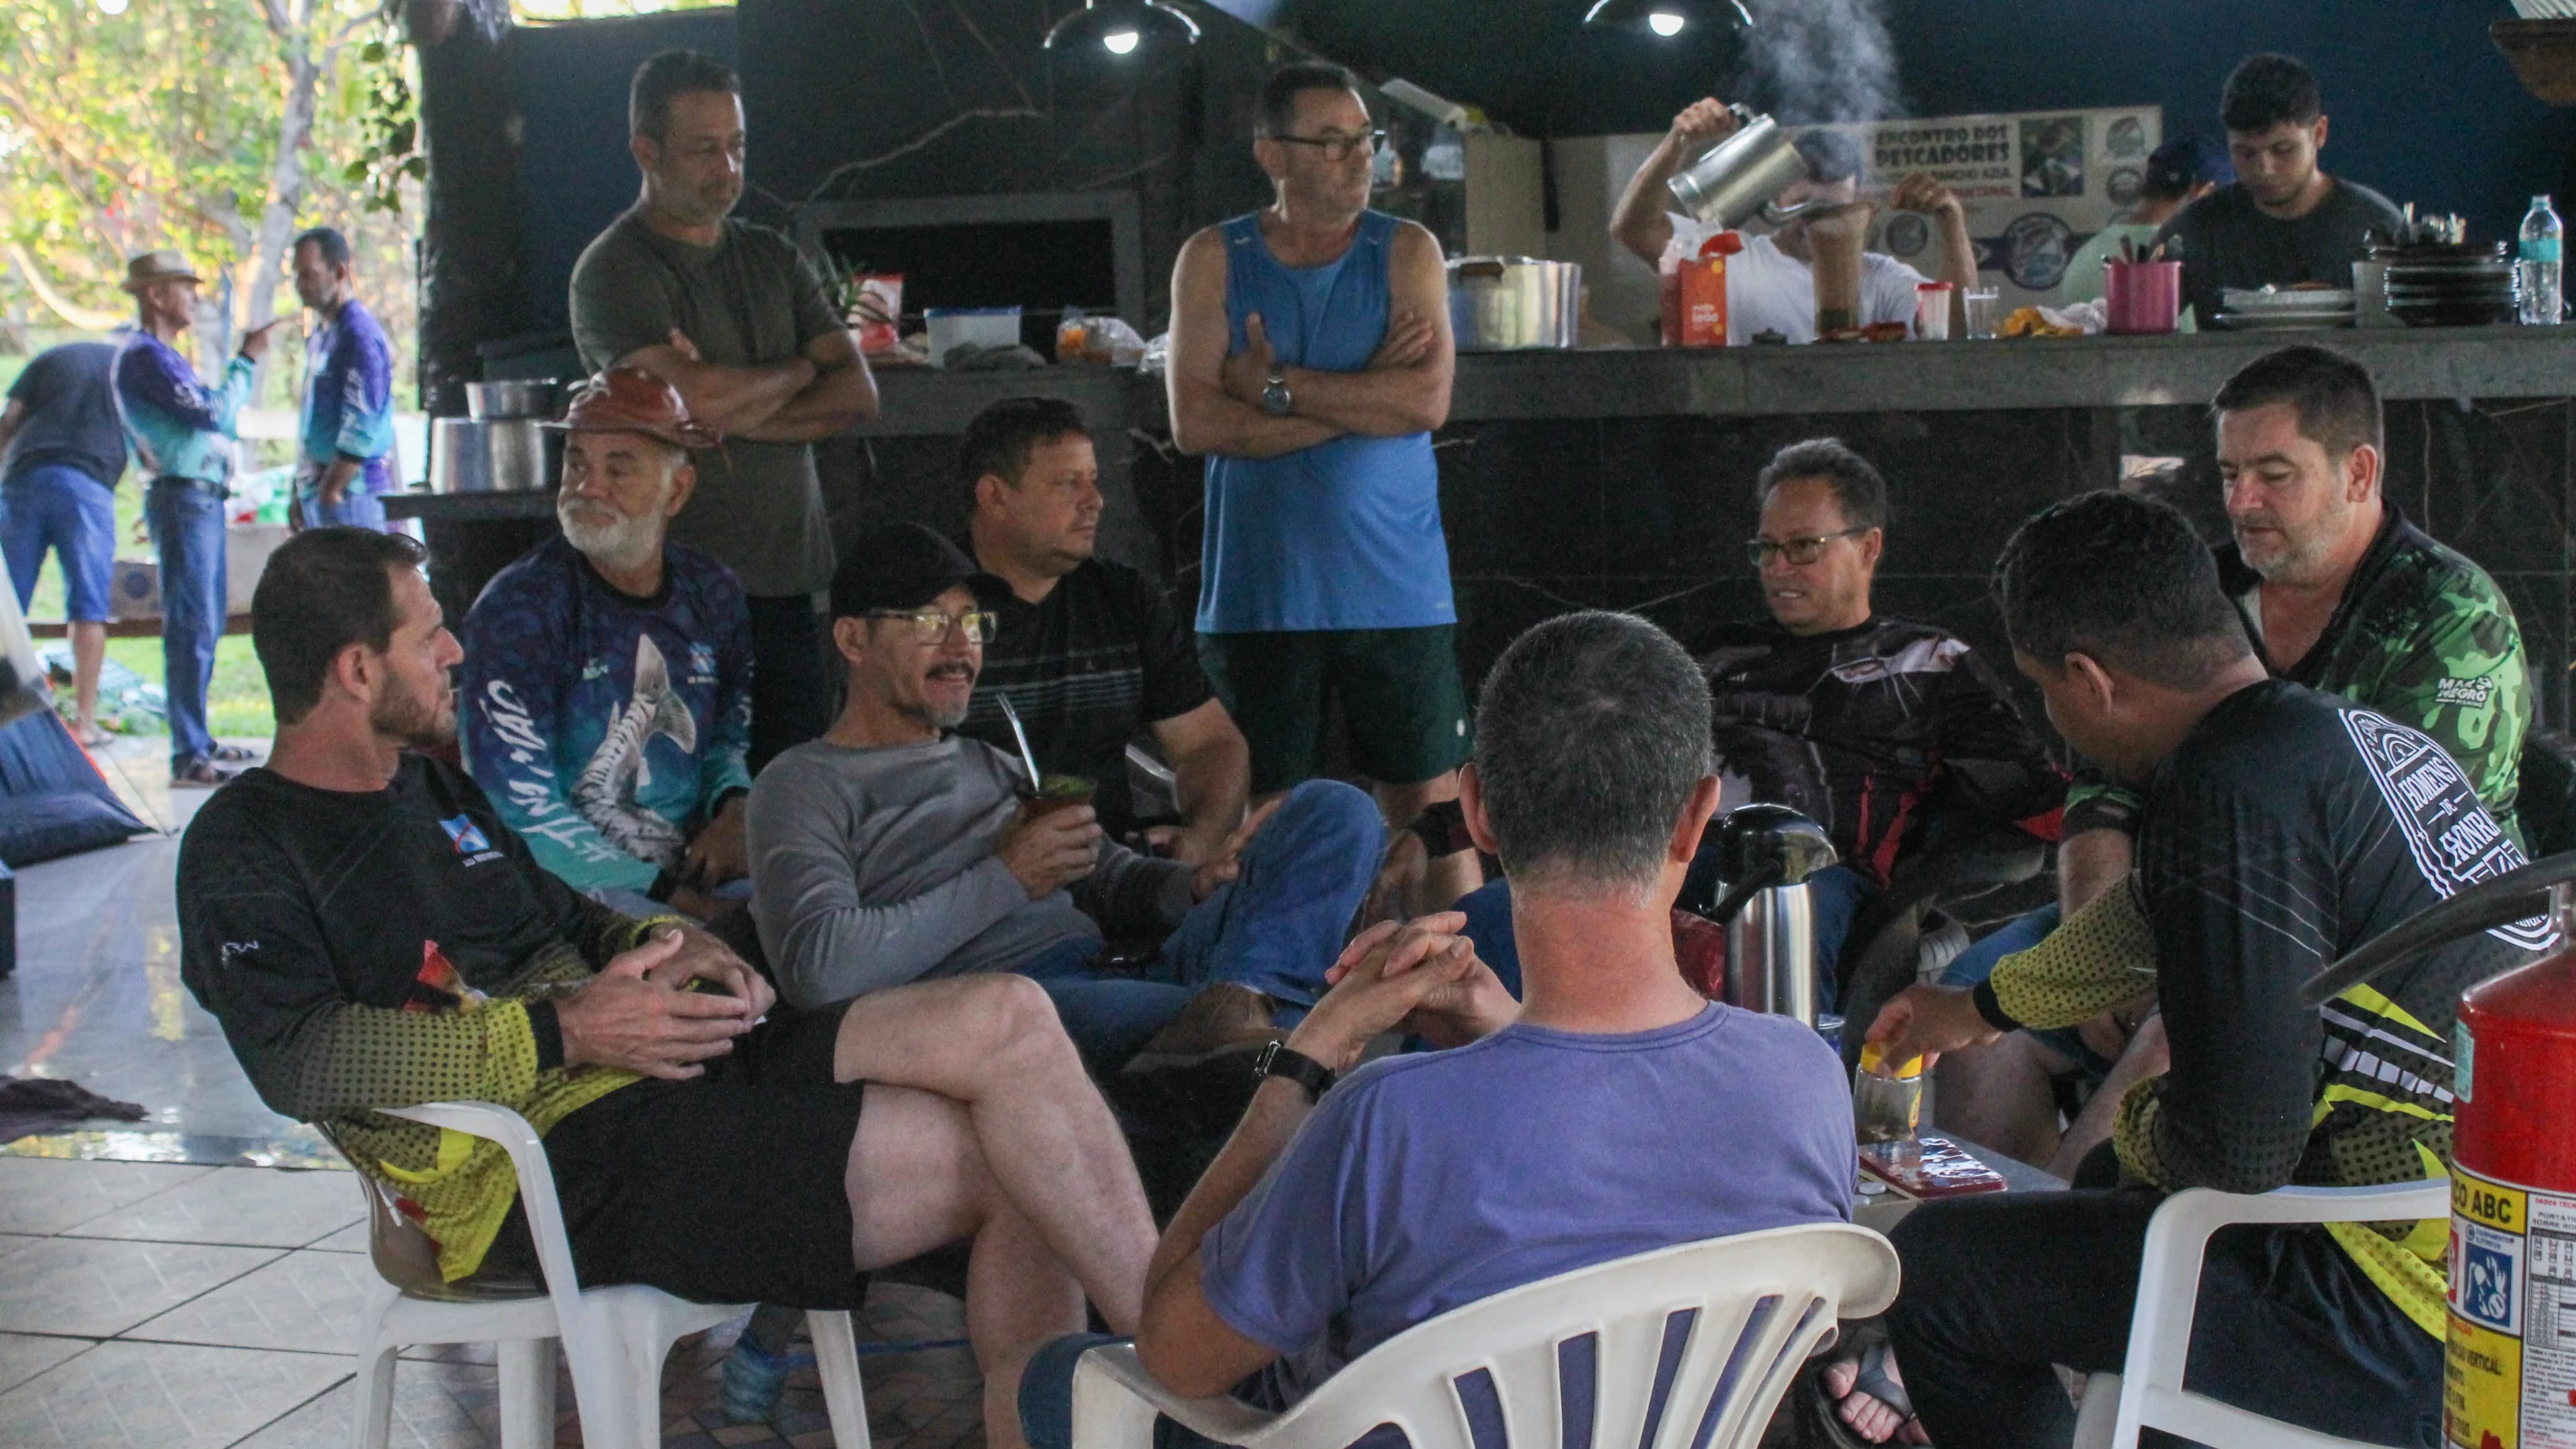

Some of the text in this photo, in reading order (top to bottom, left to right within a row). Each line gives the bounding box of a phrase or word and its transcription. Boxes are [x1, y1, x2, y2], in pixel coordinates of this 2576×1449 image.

[1874, 142, 2010, 168] PESCADORES
[2437, 688, 2487, 702] NEGRO
[2397, 755, 2457, 812] HOMENS
[2439, 798, 2458, 817] DE
[2471, 1189, 2512, 1224] ABC
